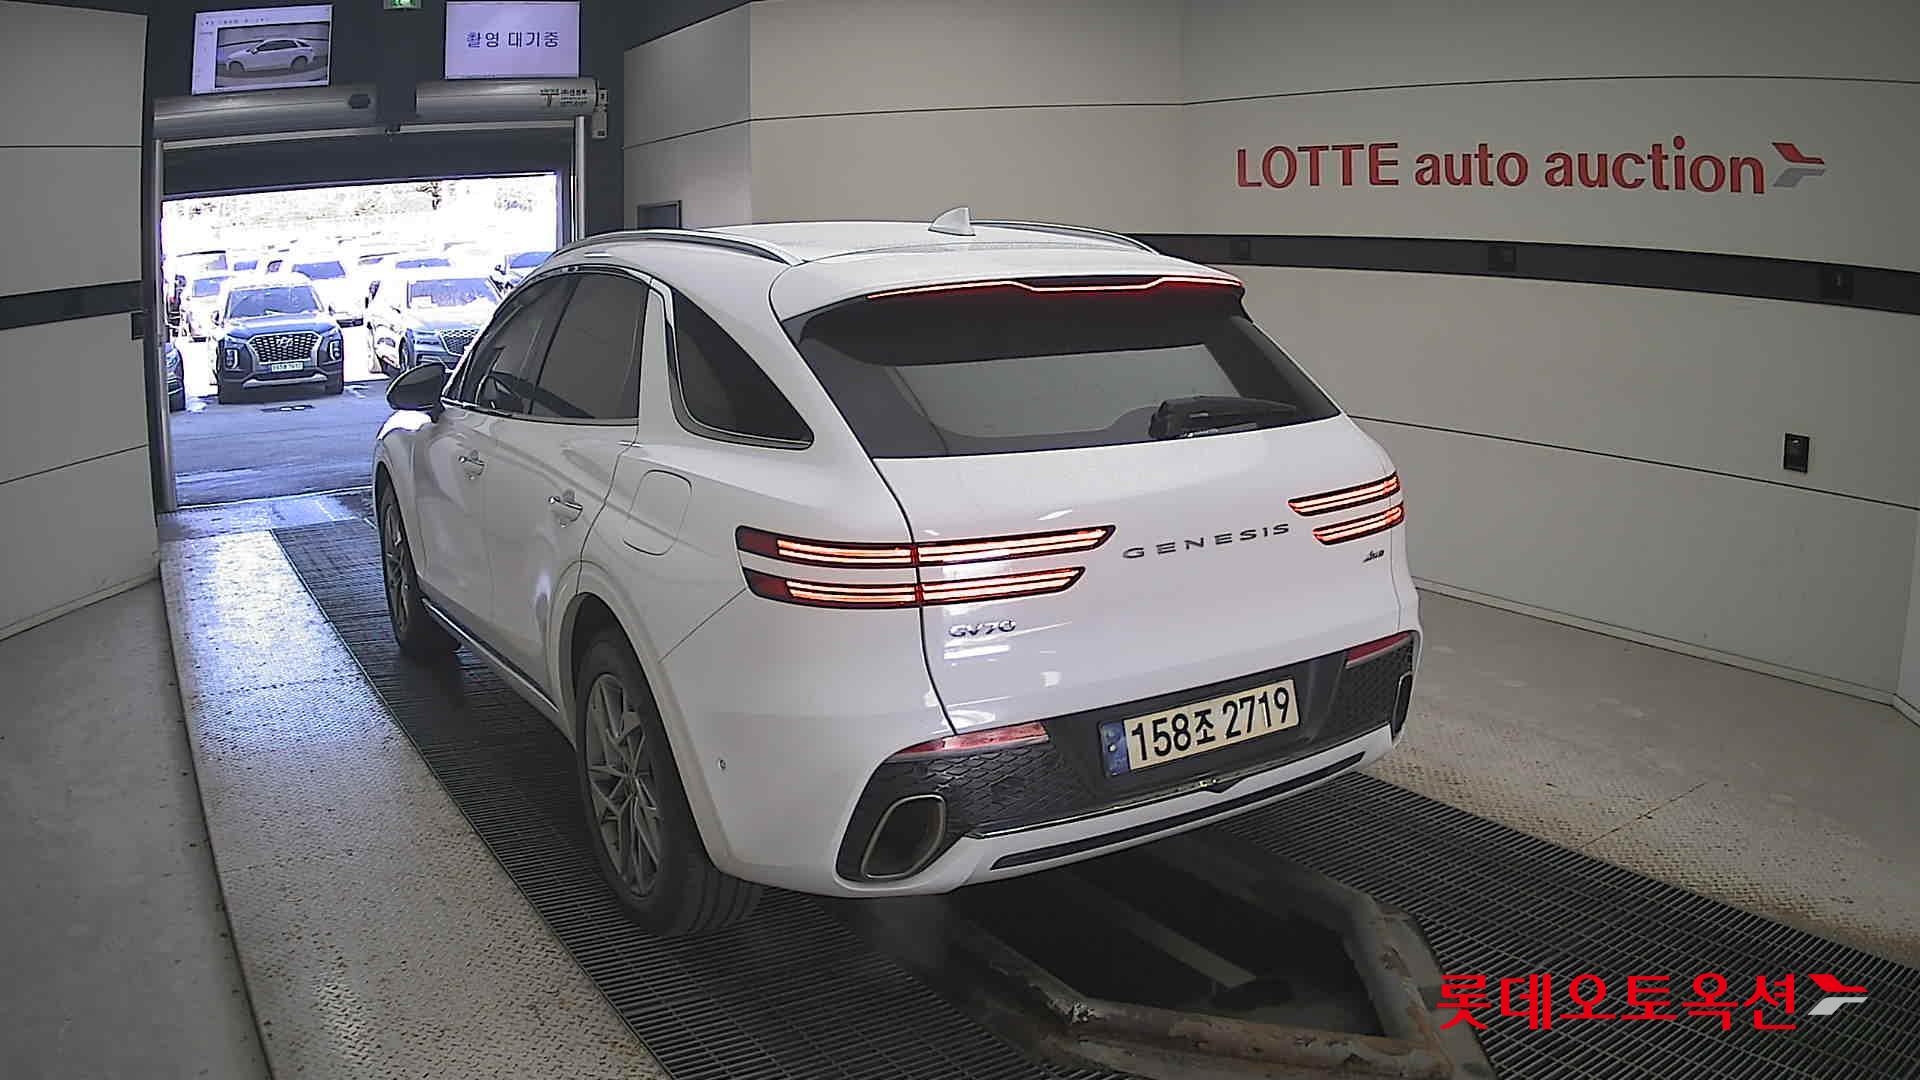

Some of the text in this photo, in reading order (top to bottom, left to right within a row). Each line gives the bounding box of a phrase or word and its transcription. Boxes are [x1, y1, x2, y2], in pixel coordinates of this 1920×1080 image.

[507, 31, 560, 48] 대기중
[1236, 136, 1765, 194] LOTTE auto auction
[1122, 523, 1289, 559] GENESIS
[948, 619, 1017, 638] GV70
[1131, 686, 1290, 761] 158조 2719
